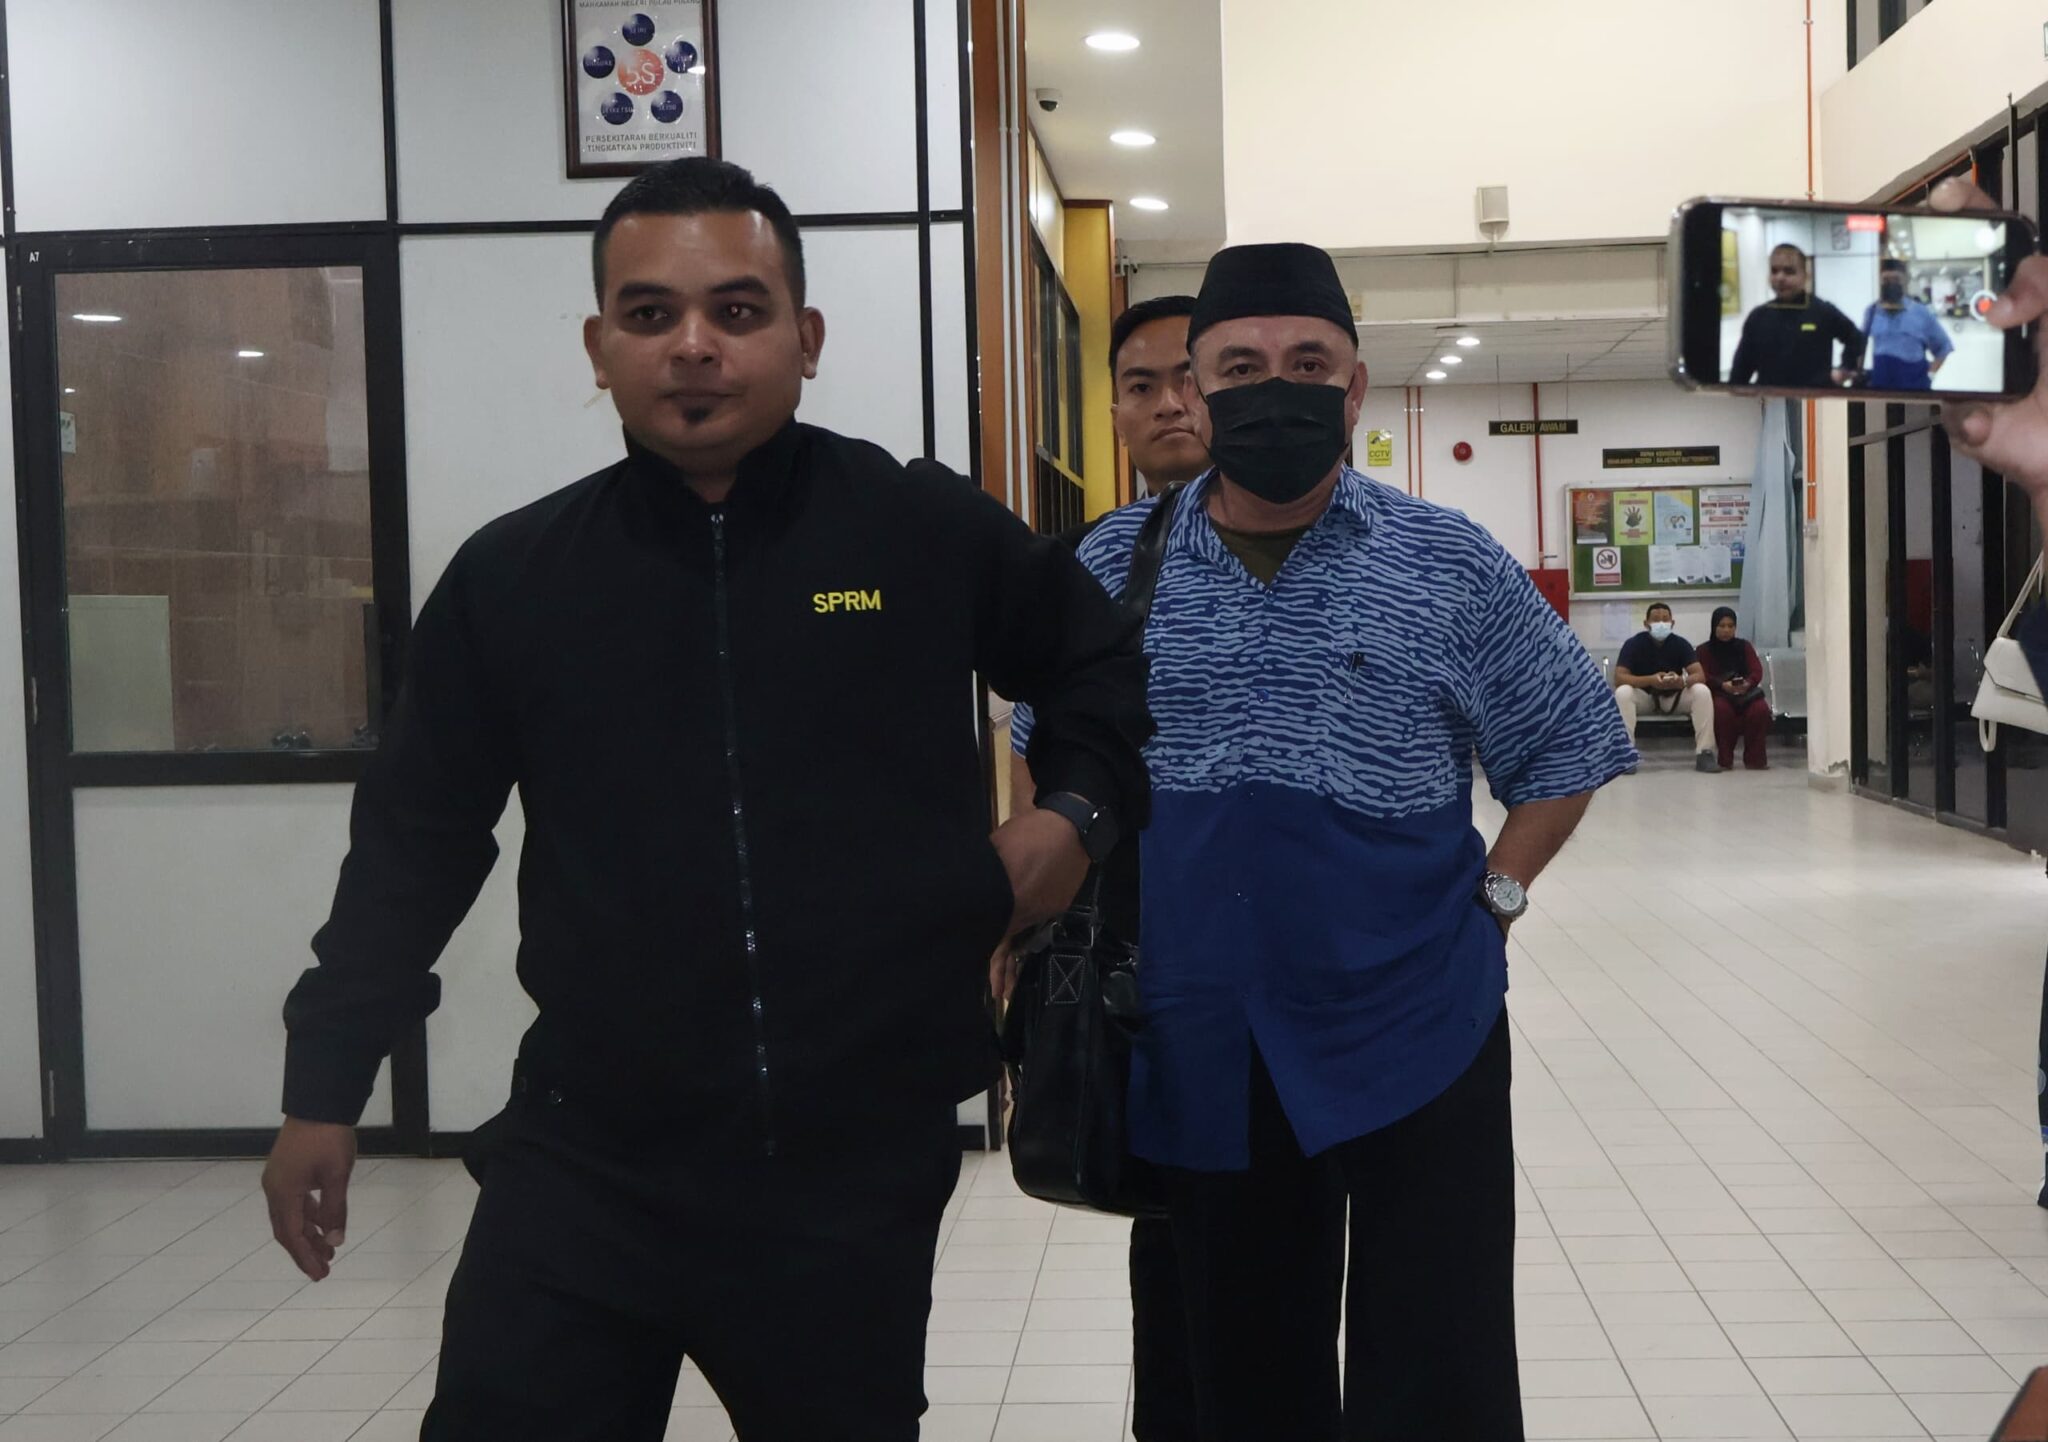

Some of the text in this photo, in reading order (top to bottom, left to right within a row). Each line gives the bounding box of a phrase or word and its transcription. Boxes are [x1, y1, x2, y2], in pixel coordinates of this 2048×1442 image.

[585, 131, 697, 143] PERSEKITARAN BERKUALITI
[587, 141, 697, 153] TINGKATKAN PRODUKTIVITI
[29, 251, 40, 263] A7
[1500, 421, 1567, 433] GALERI AWAM
[1369, 450, 1390, 458] CCTV
[812, 589, 882, 613] SPRM
